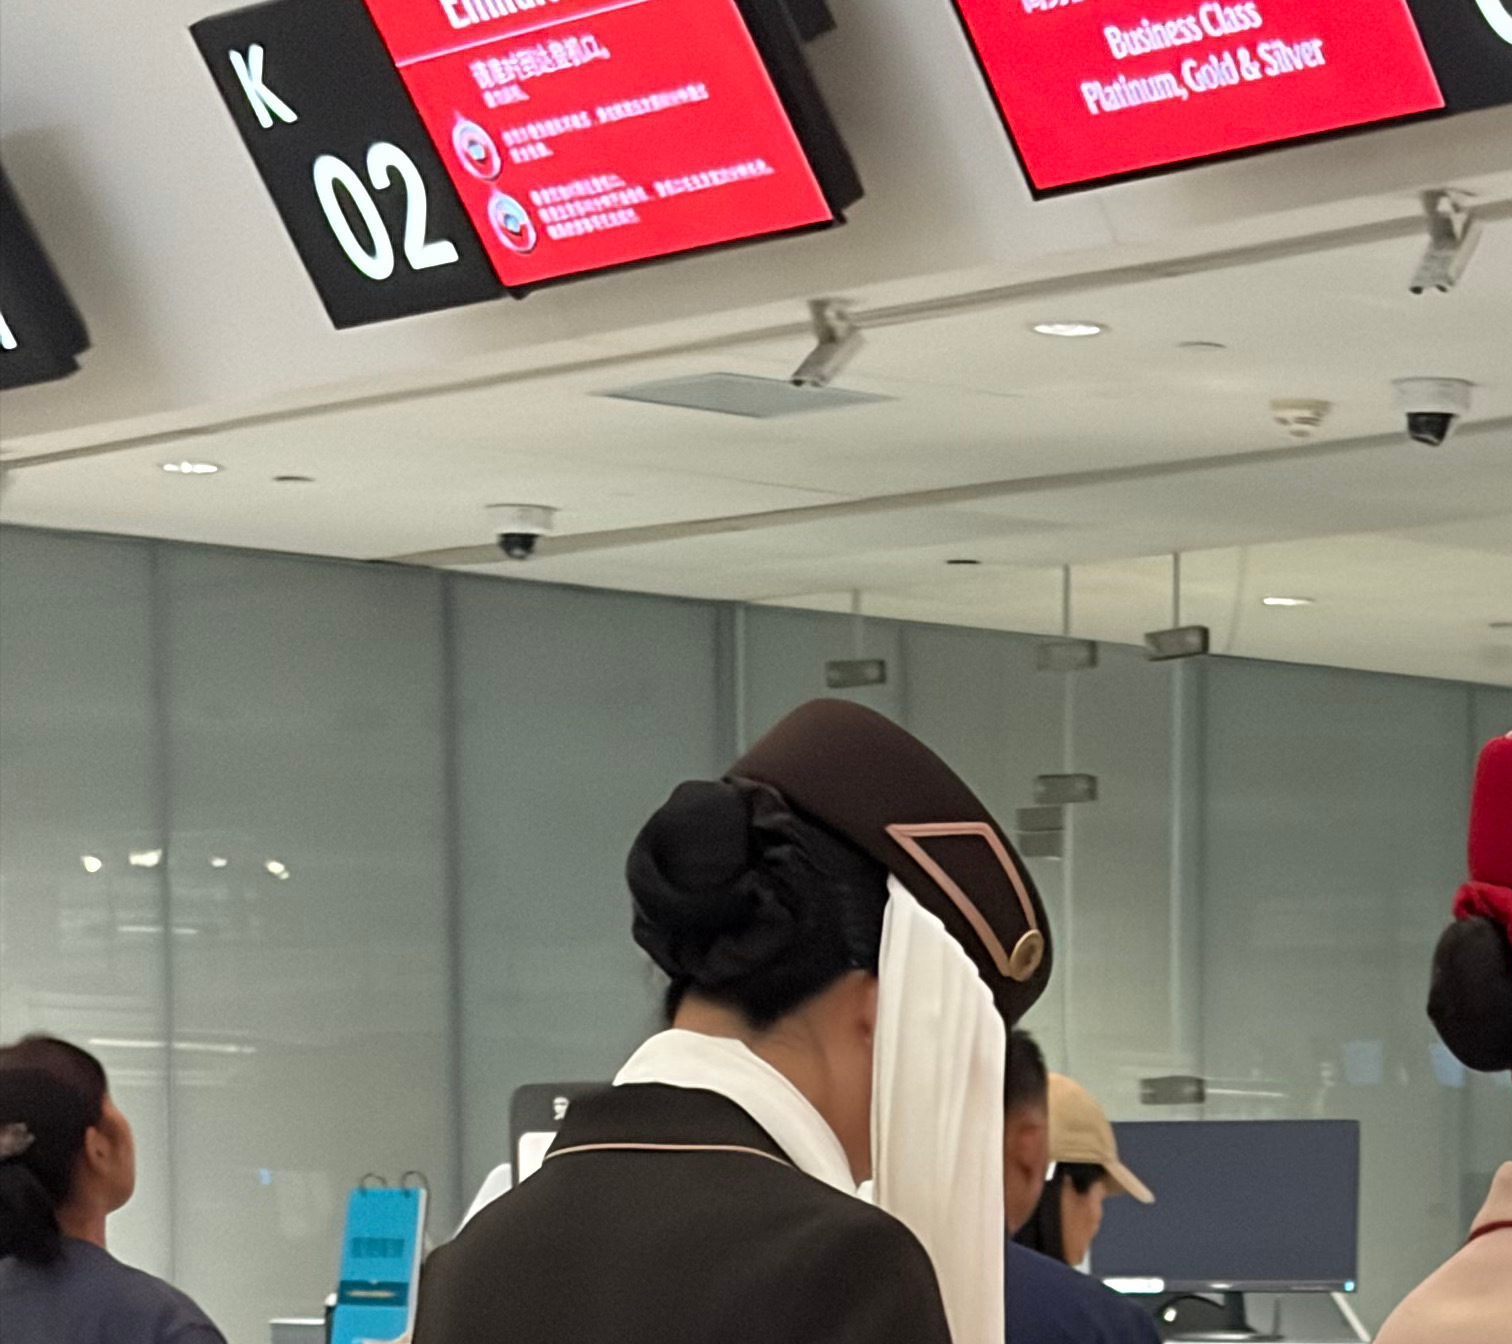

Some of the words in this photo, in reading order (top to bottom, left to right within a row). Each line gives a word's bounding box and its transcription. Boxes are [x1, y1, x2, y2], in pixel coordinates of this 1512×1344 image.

[1103, 17, 1203, 59] Business
[1199, 1, 1262, 37] Class
[229, 44, 297, 129] K
[1080, 73, 1188, 115] Platinum,
[1181, 50, 1239, 92] Gold
[1237, 46, 1261, 81] &
[1256, 38, 1325, 76] Silver
[313, 142, 459, 280] 02
